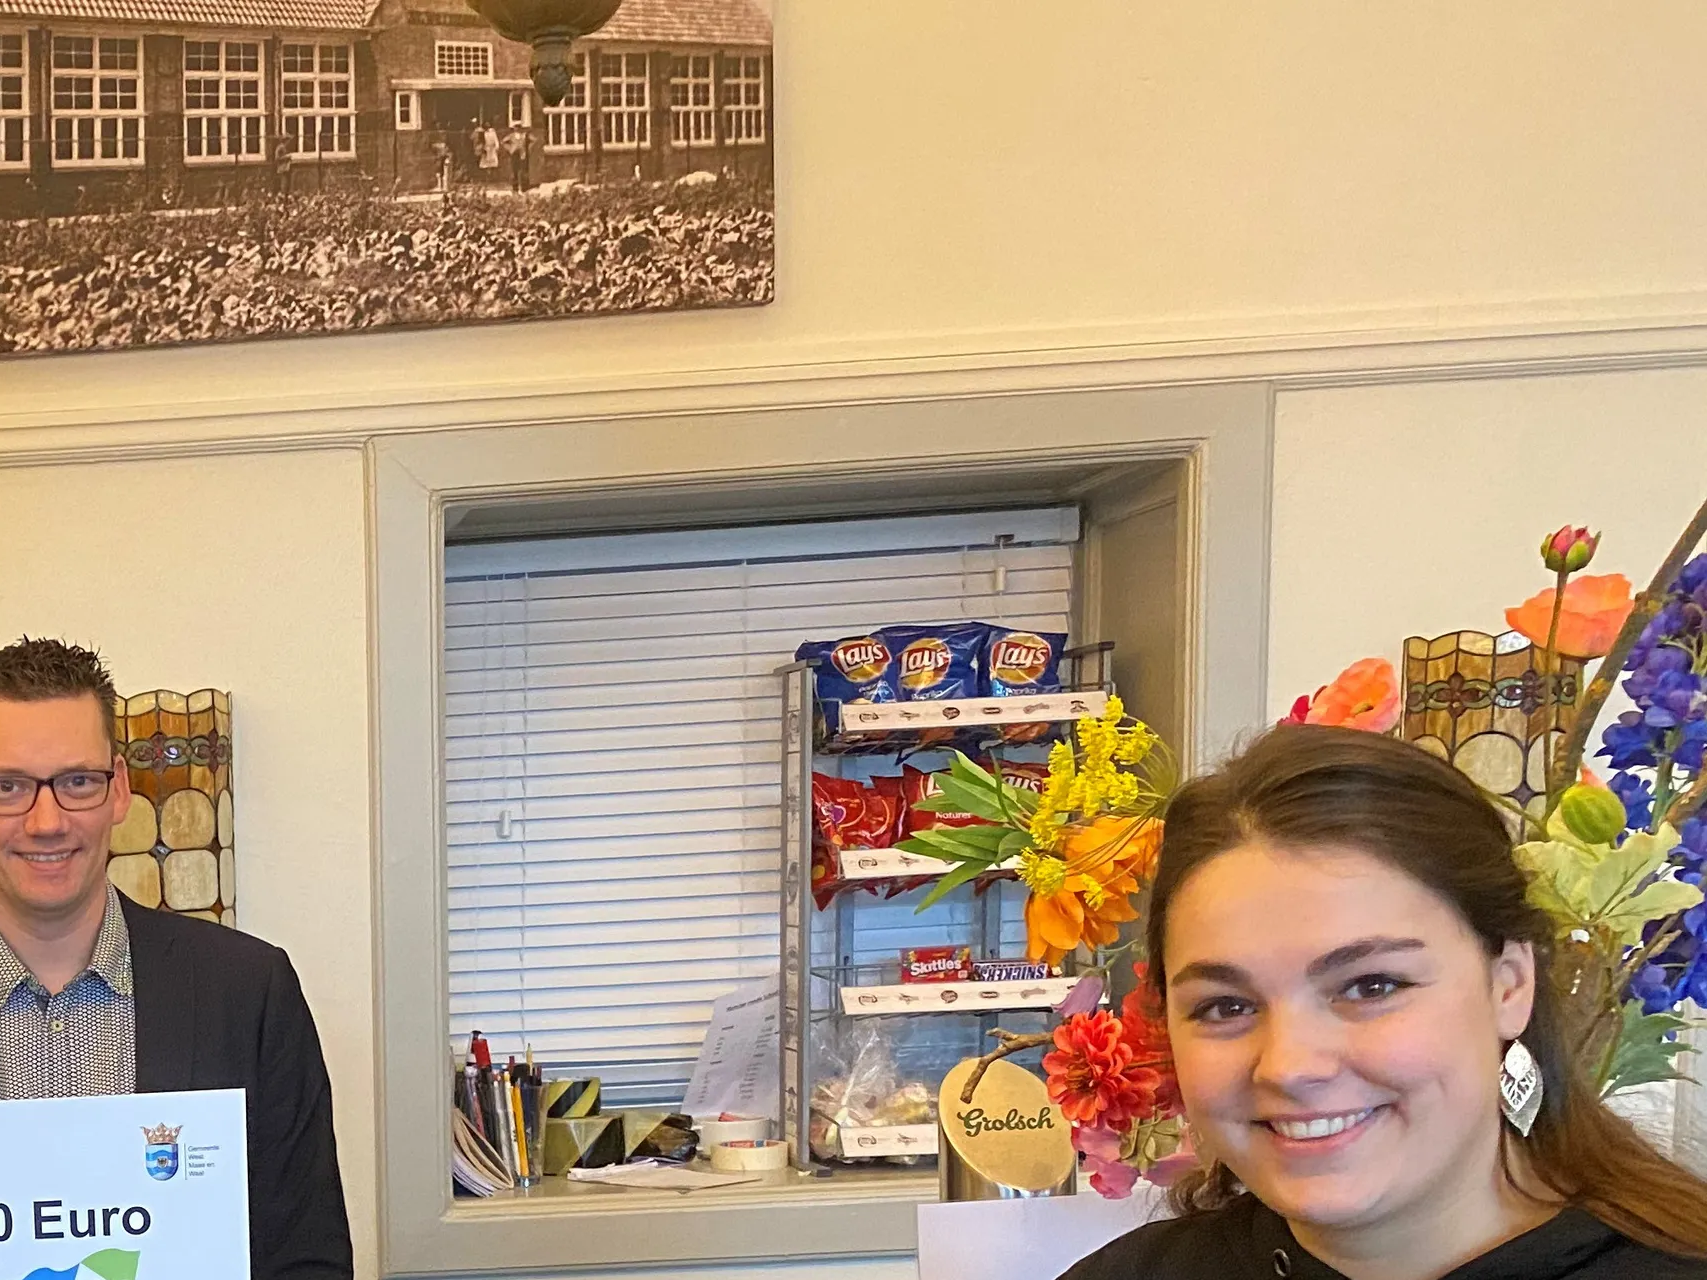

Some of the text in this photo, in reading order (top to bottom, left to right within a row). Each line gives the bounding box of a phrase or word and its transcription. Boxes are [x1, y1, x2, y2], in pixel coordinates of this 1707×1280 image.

[836, 641, 885, 673] Lay's
[996, 640, 1046, 670] Lay's
[910, 959, 962, 977] Skittles
[957, 1106, 1055, 1137] Grolsch
[33, 1200, 152, 1239] Euro
